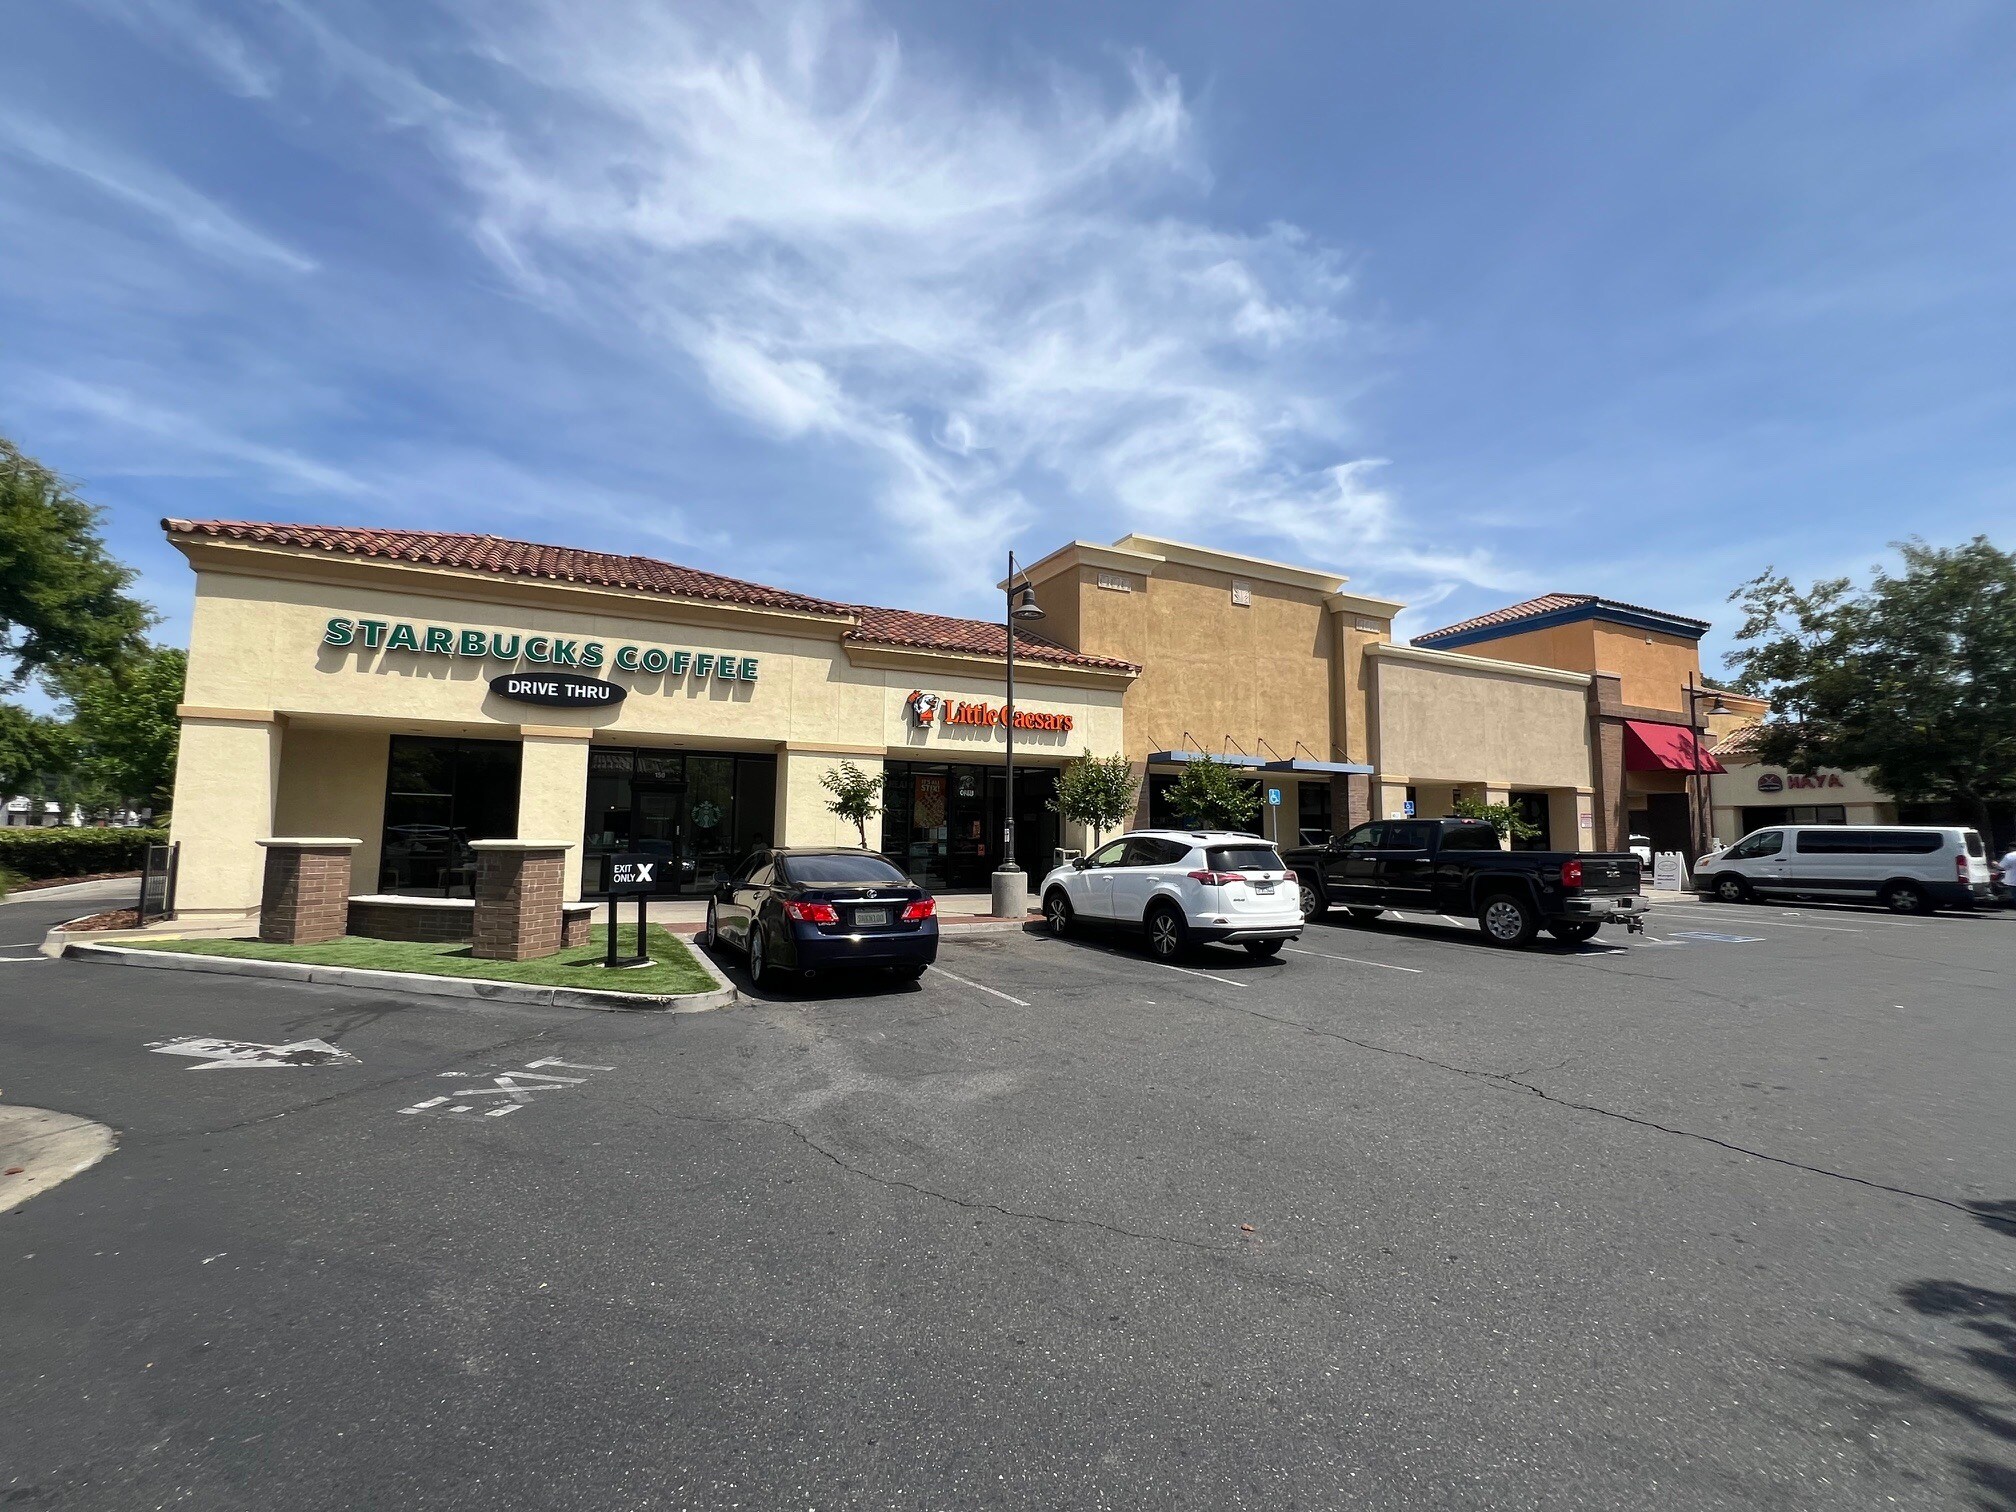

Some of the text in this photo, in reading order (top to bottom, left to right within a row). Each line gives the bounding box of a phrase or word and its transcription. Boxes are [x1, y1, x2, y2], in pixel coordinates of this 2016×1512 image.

[323, 616, 758, 682] STARBUCKS COFFEE
[508, 680, 610, 699] DRIVE THRU
[944, 700, 1073, 731] Little Caesars
[613, 873, 636, 883] ONLY
[614, 864, 633, 873] EXIT
